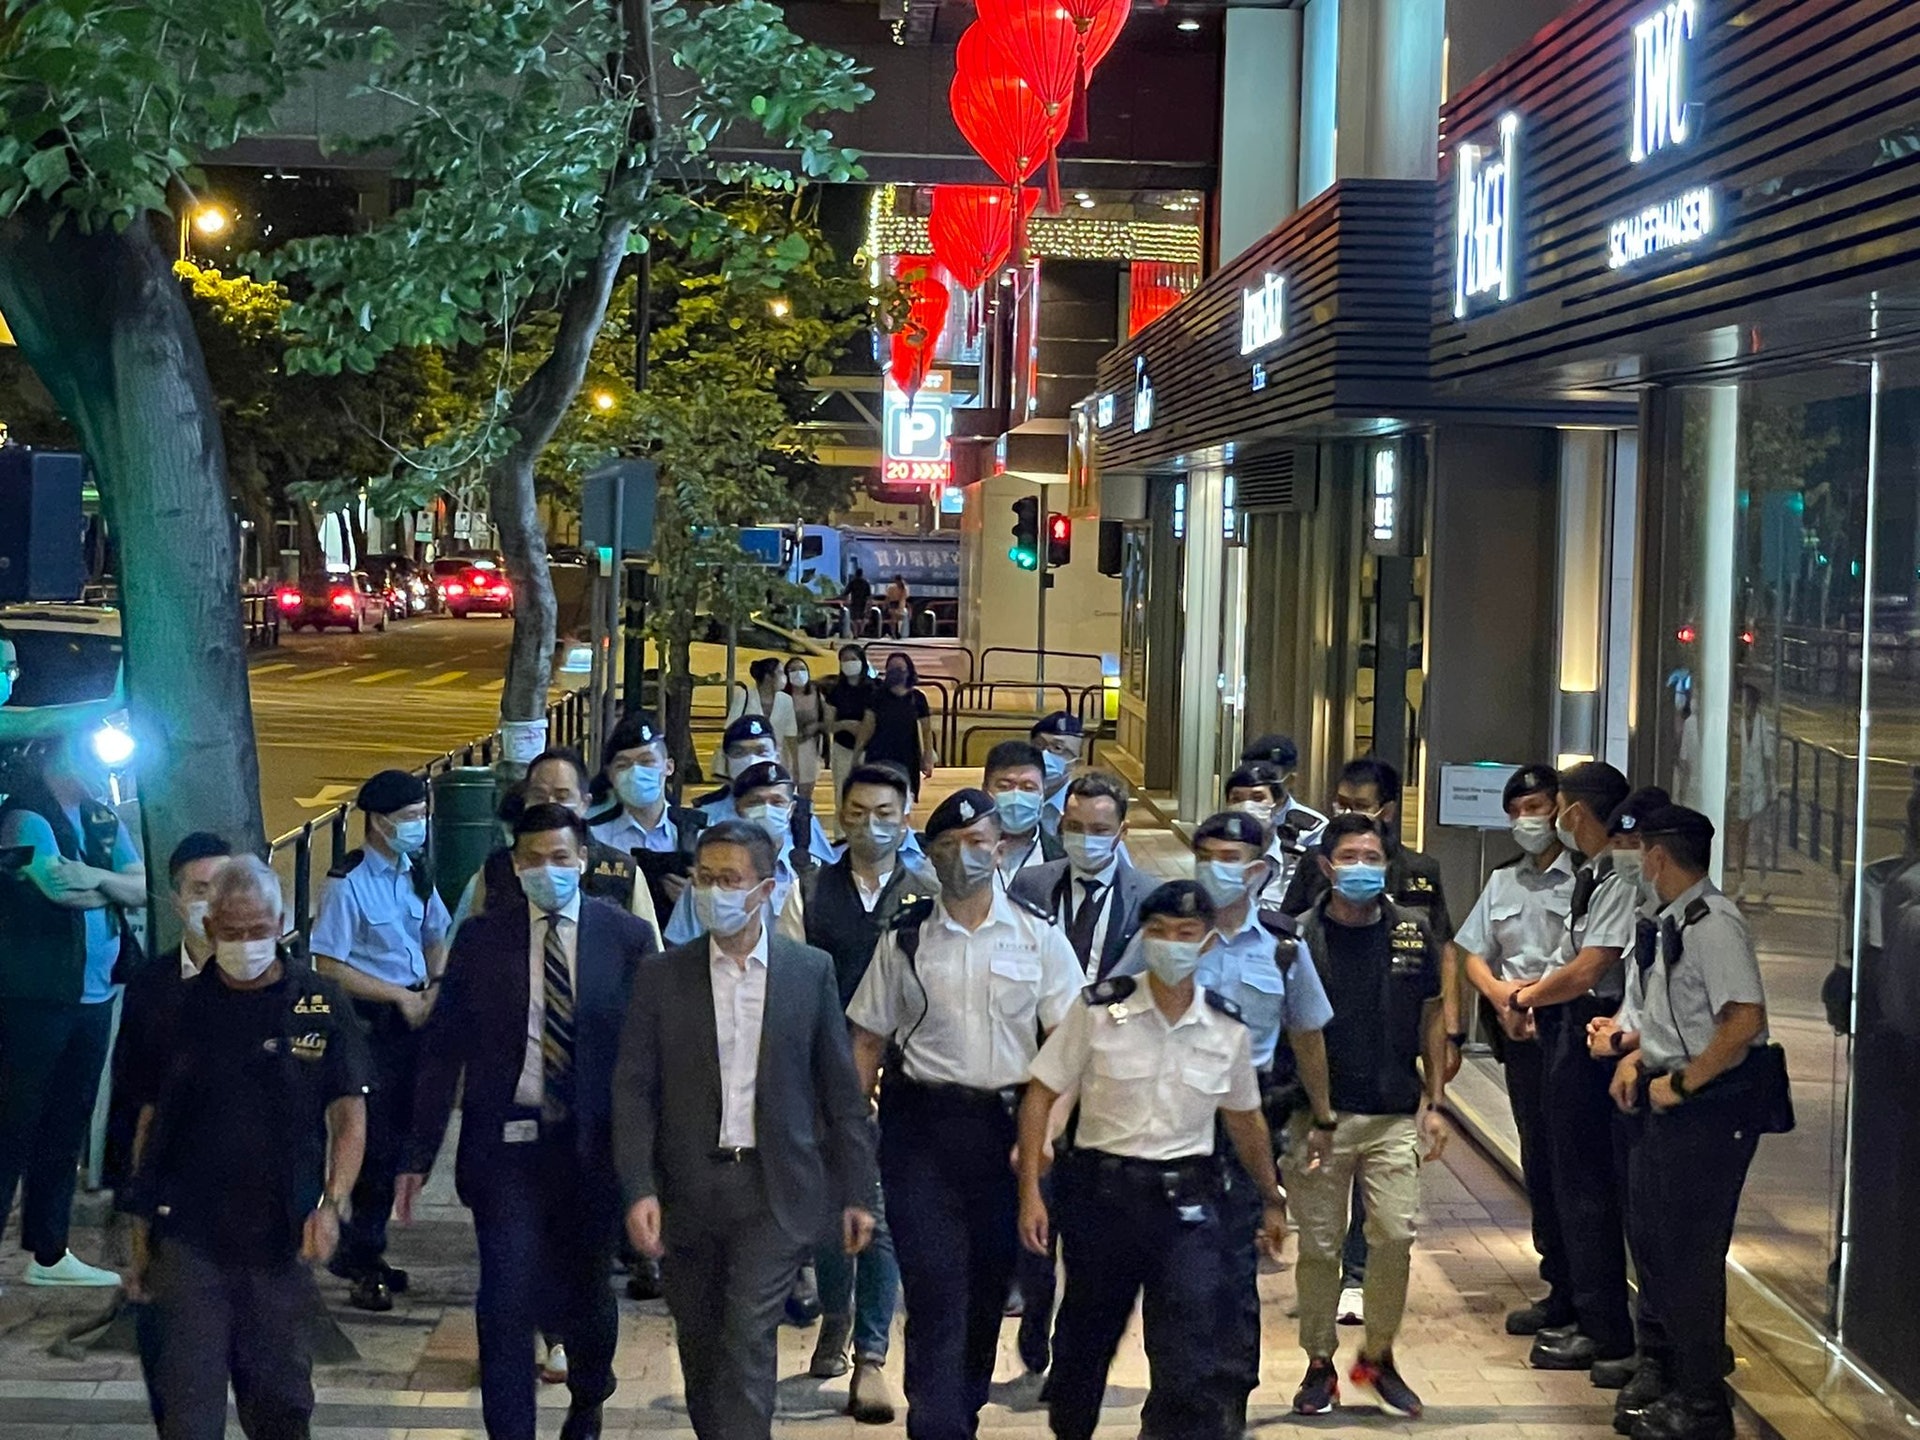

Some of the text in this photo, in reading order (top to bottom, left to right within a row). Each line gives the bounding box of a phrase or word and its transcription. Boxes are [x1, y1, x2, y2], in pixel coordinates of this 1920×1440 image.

[1630, 0, 1695, 162] IWC
[899, 411, 936, 455] P
[886, 462, 910, 479] 20
